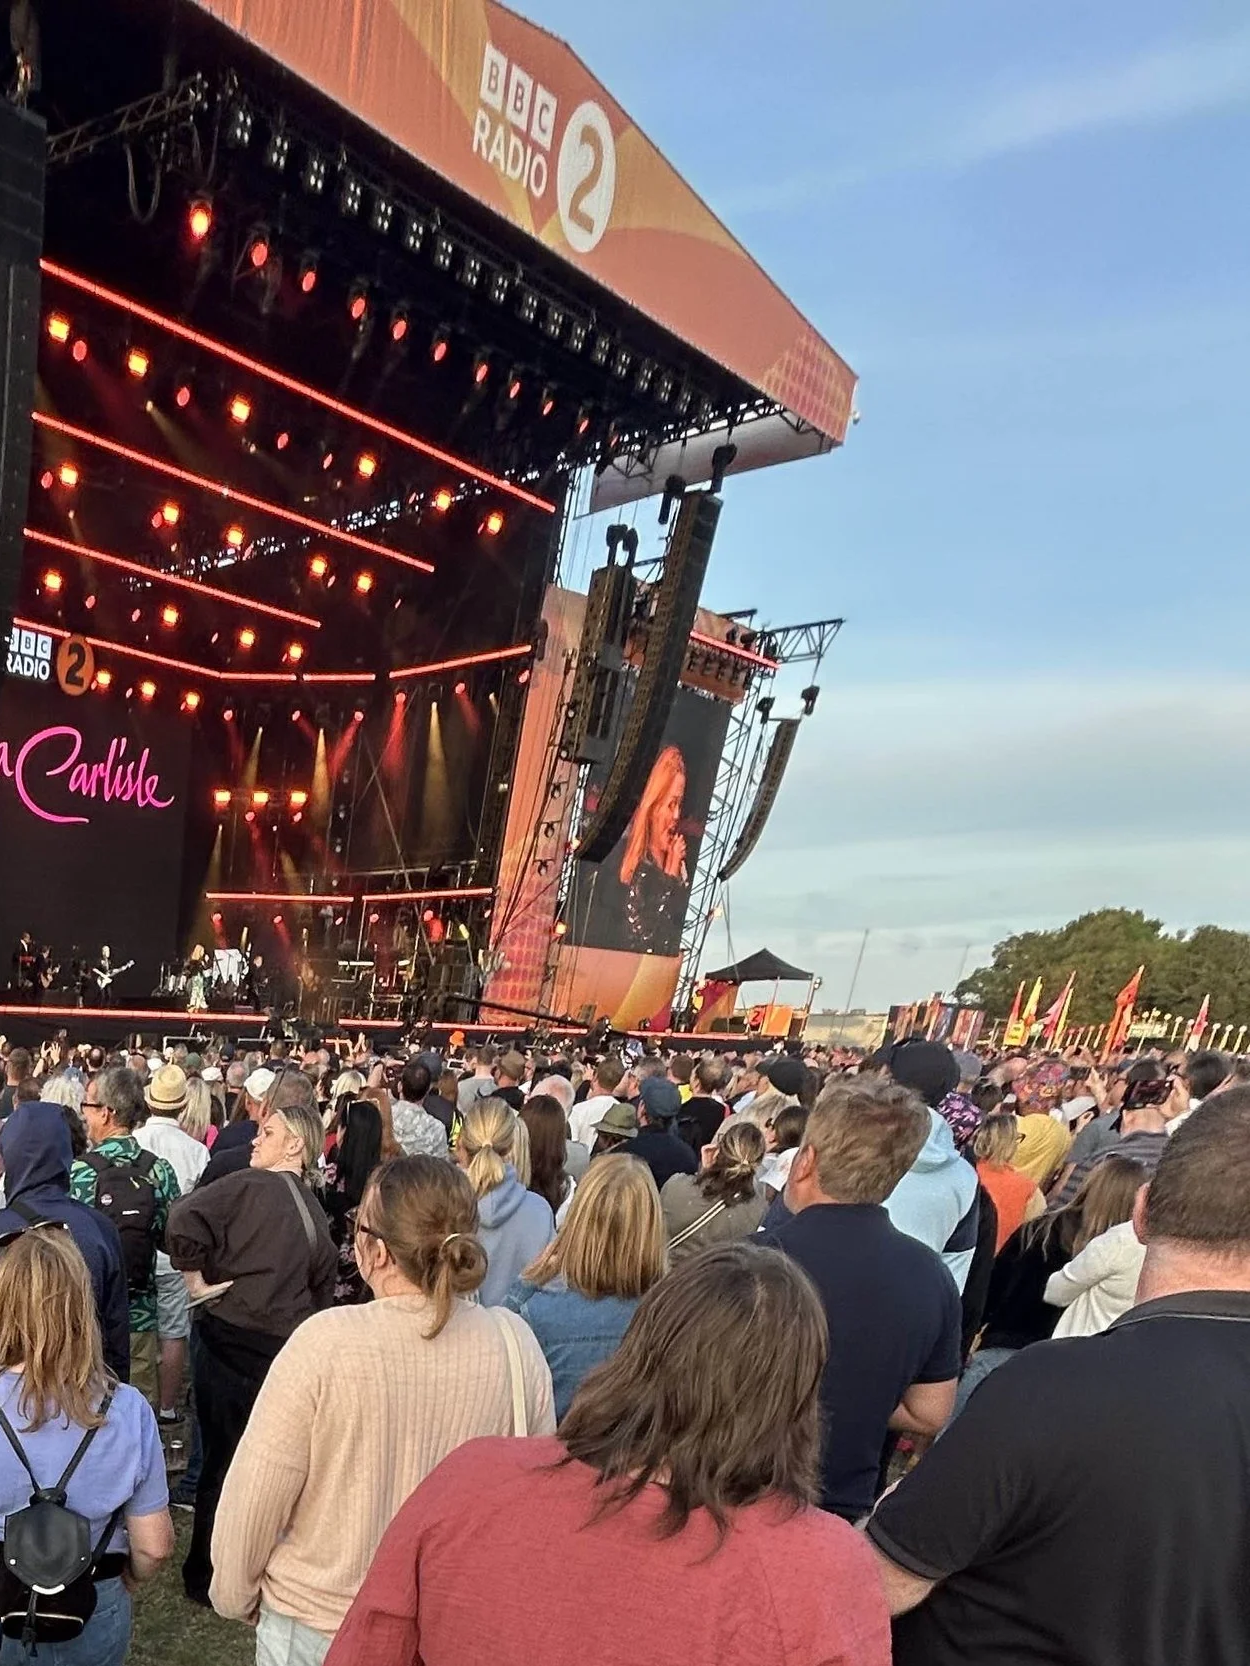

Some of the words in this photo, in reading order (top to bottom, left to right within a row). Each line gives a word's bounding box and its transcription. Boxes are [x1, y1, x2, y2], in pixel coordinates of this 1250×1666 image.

[479, 41, 558, 152] BBC
[472, 109, 548, 198] RADIO
[568, 123, 604, 235] 2
[65, 642, 86, 688] 2
[15, 725, 175, 824] Carlisle
